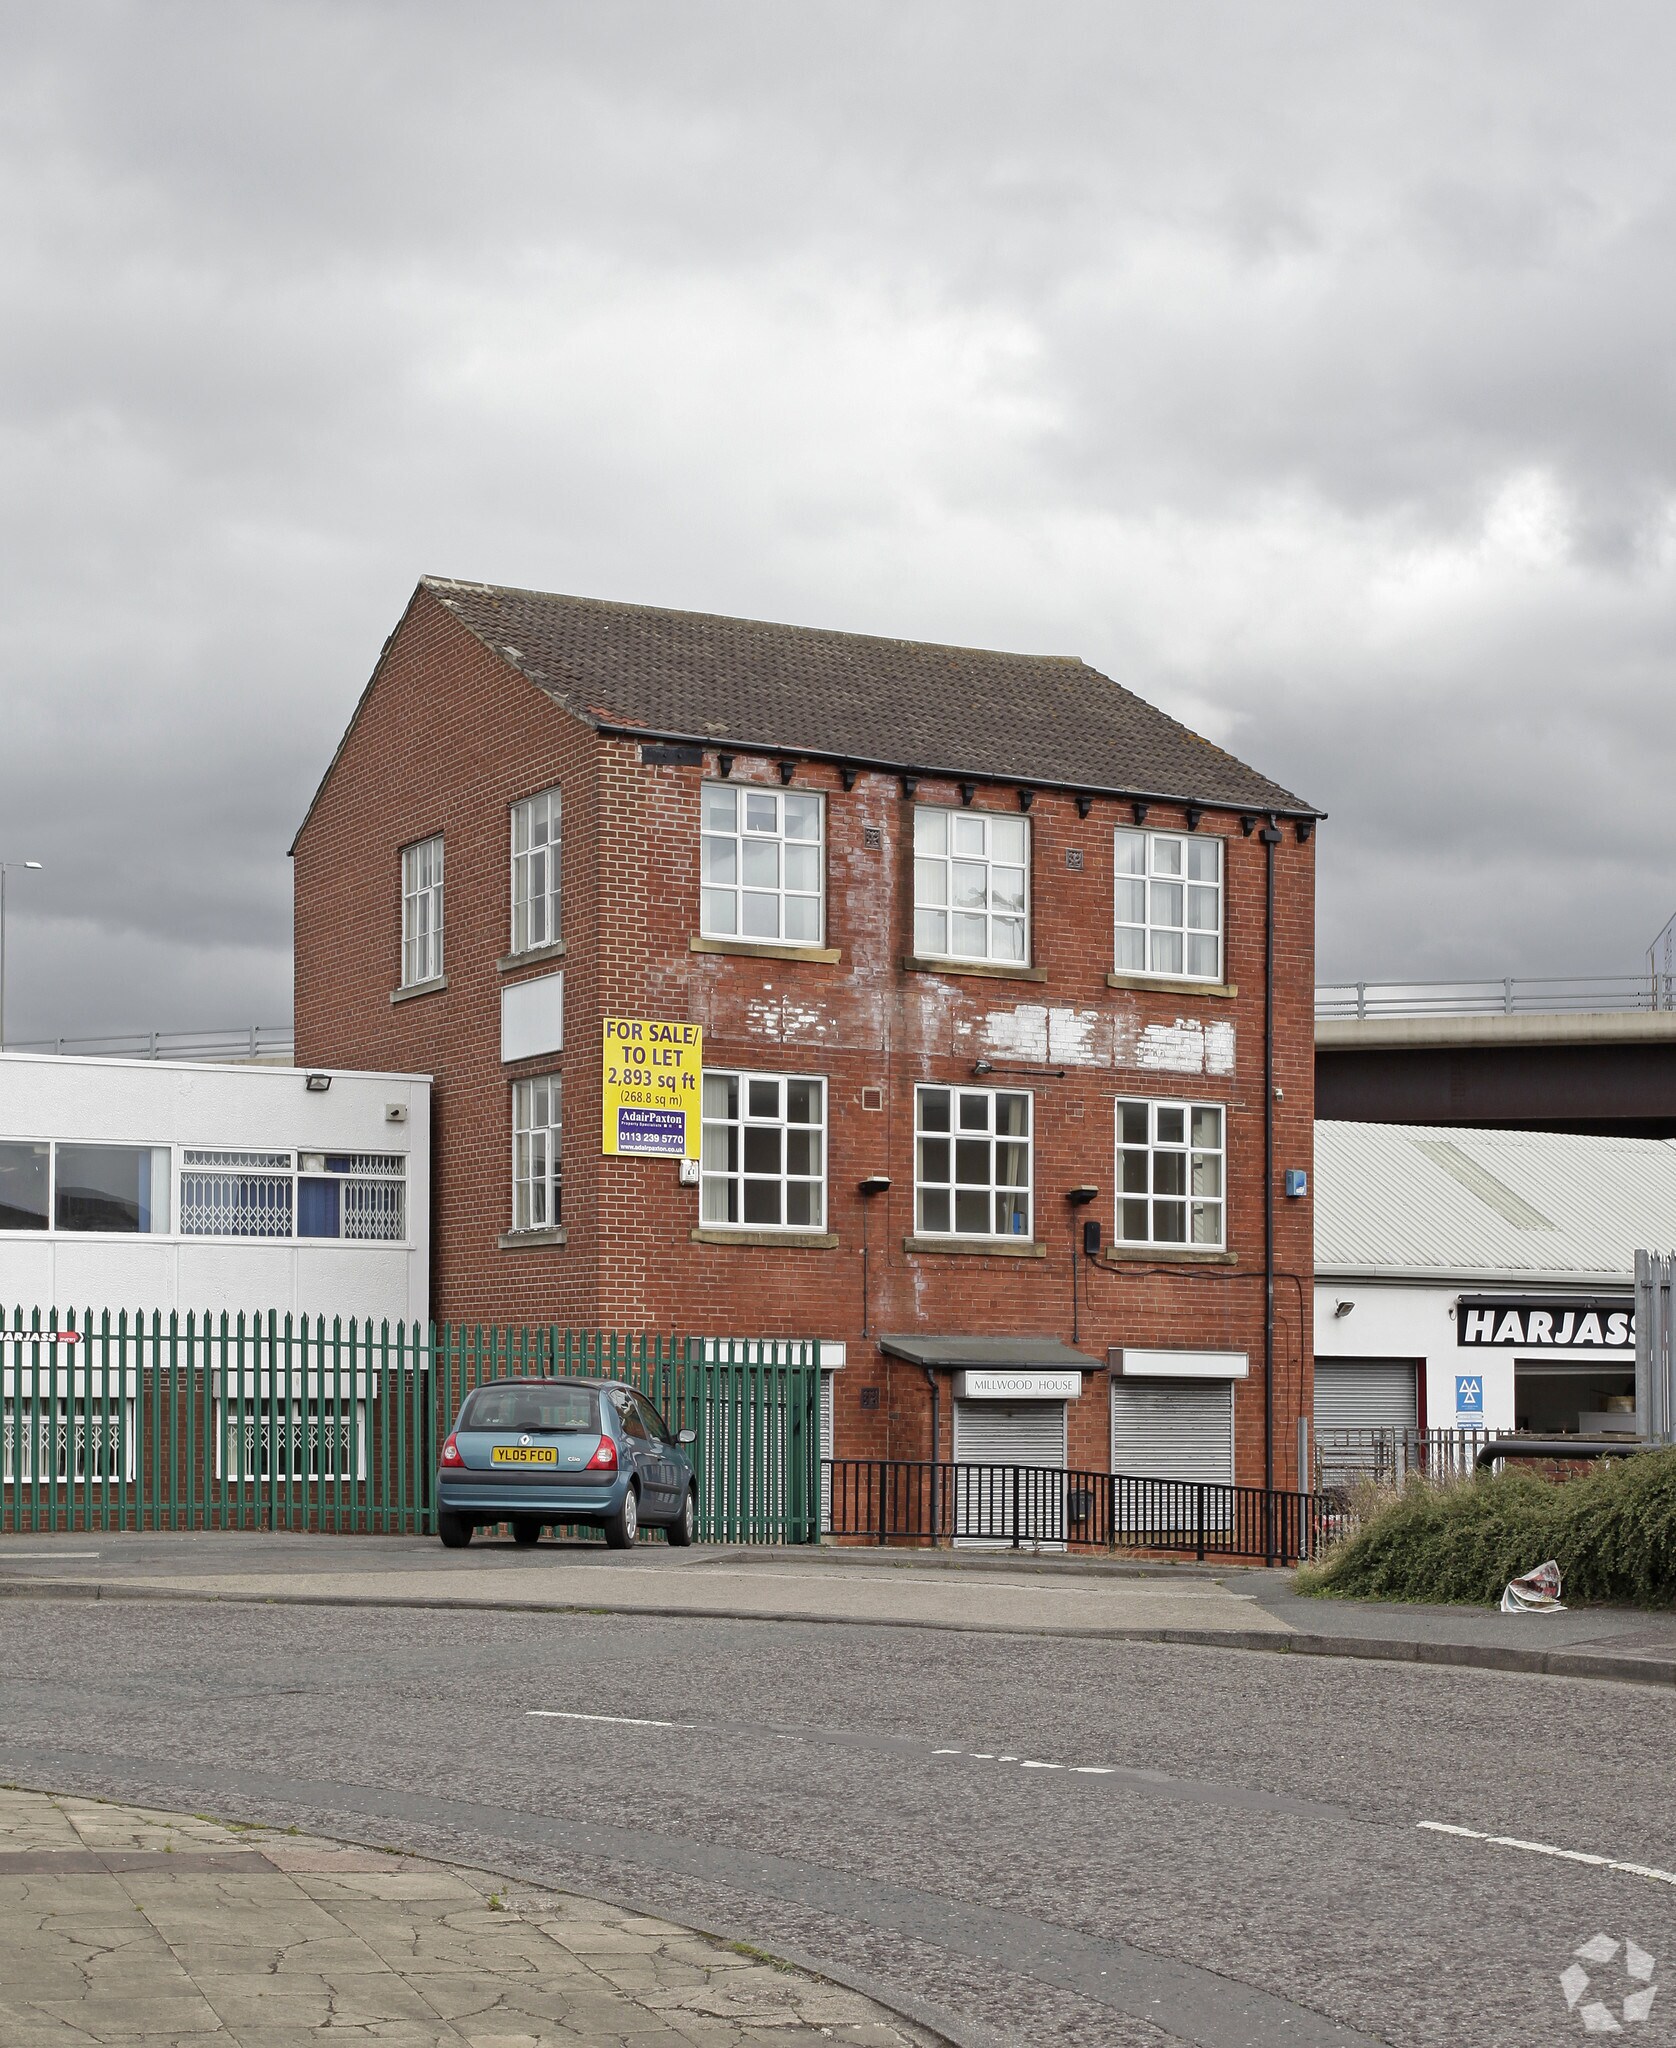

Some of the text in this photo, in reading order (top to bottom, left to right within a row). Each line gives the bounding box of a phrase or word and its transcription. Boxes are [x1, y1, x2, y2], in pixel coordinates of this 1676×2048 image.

[607, 1021, 699, 1046] FOR SALE/
[622, 1046, 683, 1067] TO LET
[608, 1067, 695, 1093] 2,893 sq ft
[620, 1089, 682, 1107] (268.8 sq m)
[621, 1111, 682, 1124] AdairPaxton
[620, 1132, 684, 1144] 0113 239 5770
[620, 1144, 683, 1153] www.adairpaxton.co.uk
[1464, 1310, 1635, 1345] HARJAS
[974, 1380, 1073, 1390] MILLWOOD HOUSE
[498, 1449, 552, 1461] YL05 FCO
